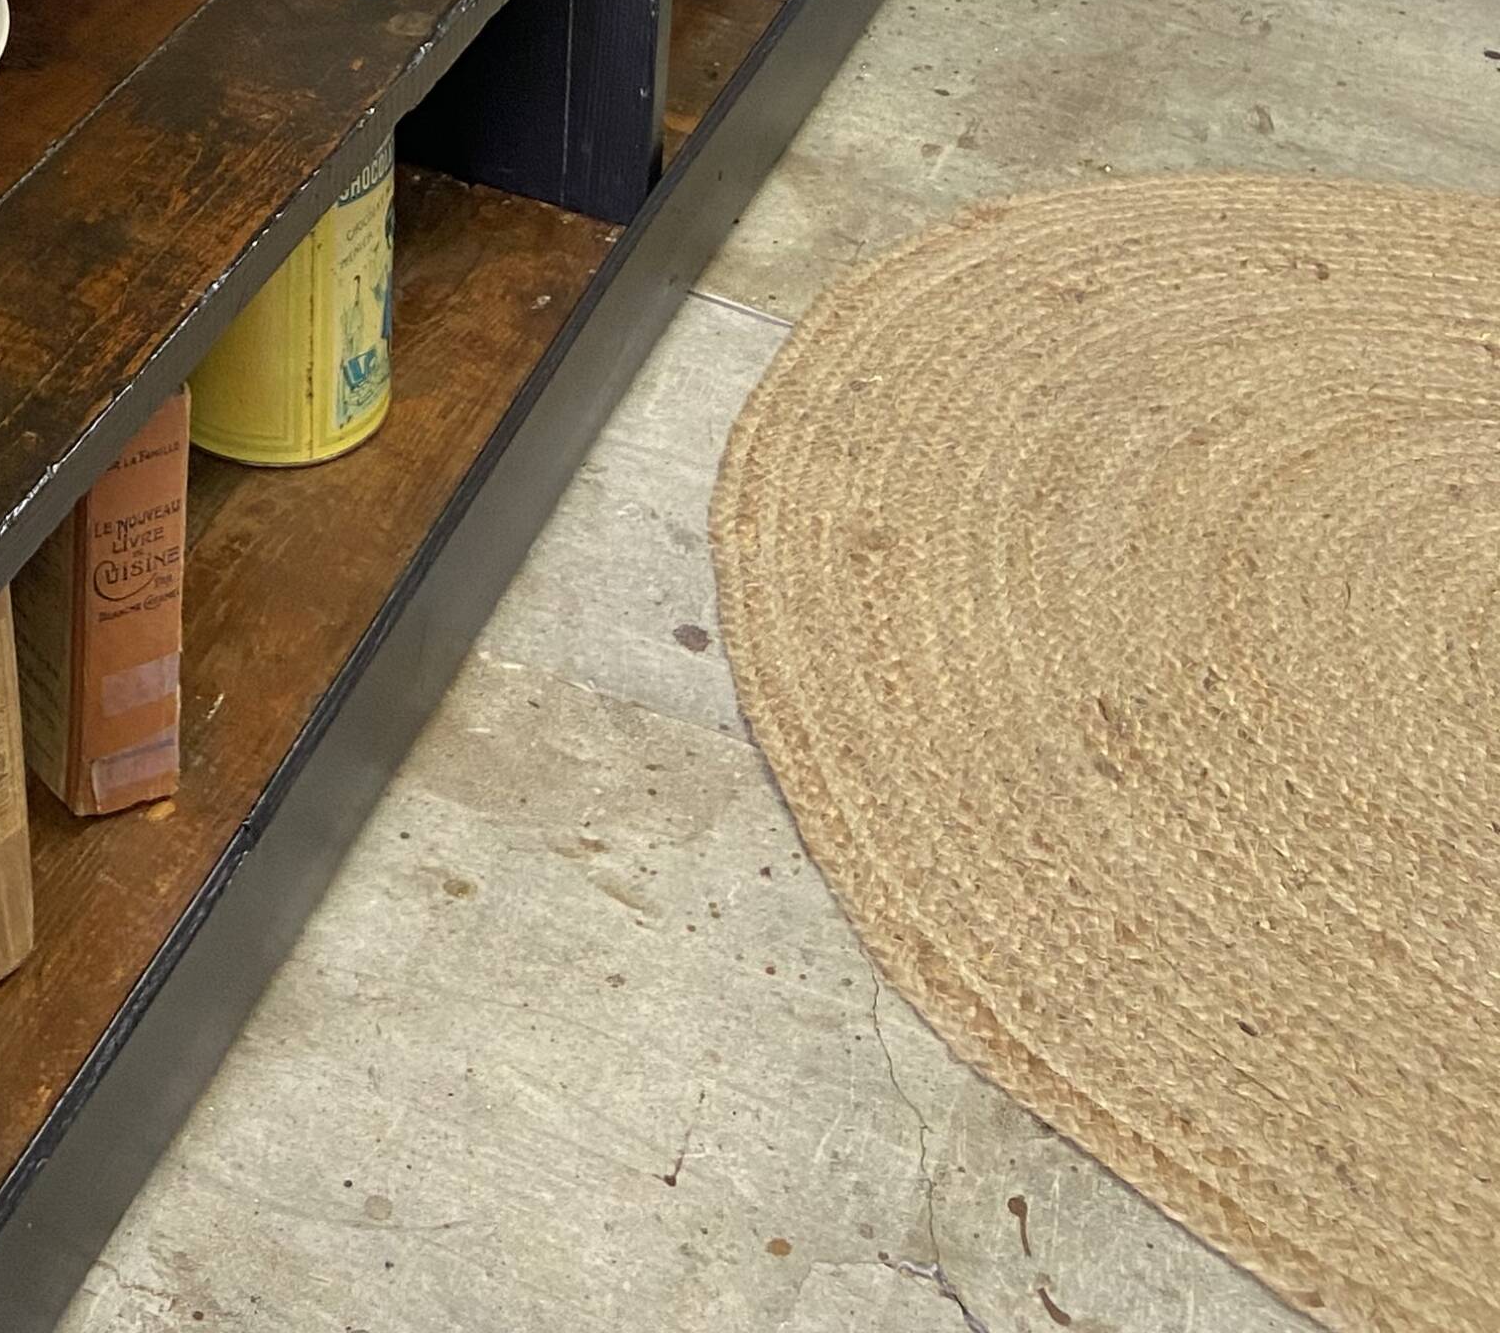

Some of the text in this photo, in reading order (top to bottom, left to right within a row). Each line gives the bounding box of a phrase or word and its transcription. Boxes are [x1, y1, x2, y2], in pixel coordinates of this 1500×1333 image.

[94, 498, 181, 541] LE NOUVEAU
[112, 526, 165, 554] LIVRE
[93, 545, 180, 602] CUISINE
